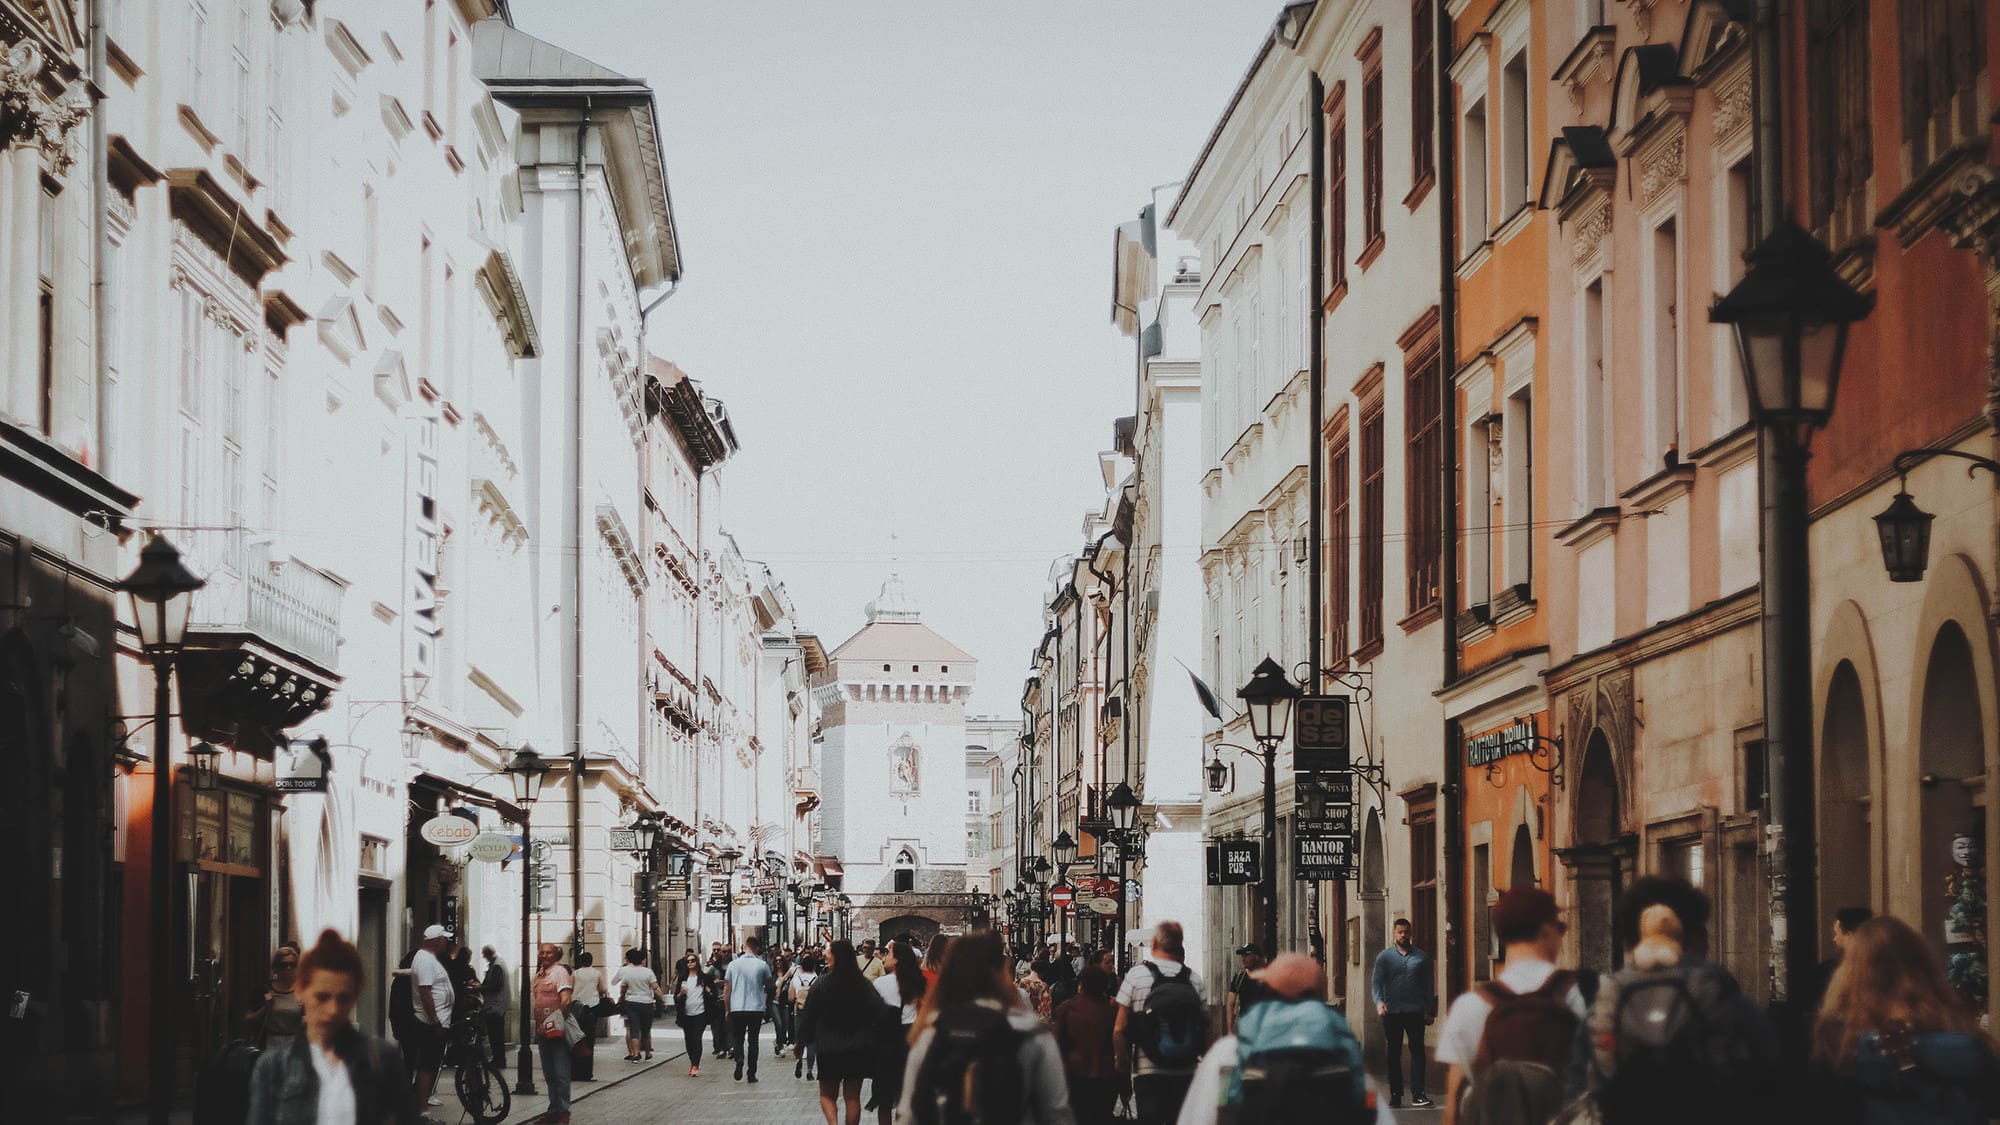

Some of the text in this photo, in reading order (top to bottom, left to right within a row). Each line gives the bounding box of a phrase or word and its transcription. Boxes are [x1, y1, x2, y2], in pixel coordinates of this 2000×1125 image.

[1300, 702, 1343, 725] de
[1302, 726, 1343, 743] sa
[295, 780, 317, 788] TOURS
[1328, 784, 1350, 793] PINTA
[1325, 808, 1348, 819] SHOP
[428, 824, 472, 838] Kebab
[473, 843, 508, 852] SYCYLIA
[1301, 840, 1344, 854] KANTOR
[1228, 850, 1251, 863] BAZA
[1301, 854, 1344, 866] EXCHANGE
[1228, 862, 1245, 874] PUB
